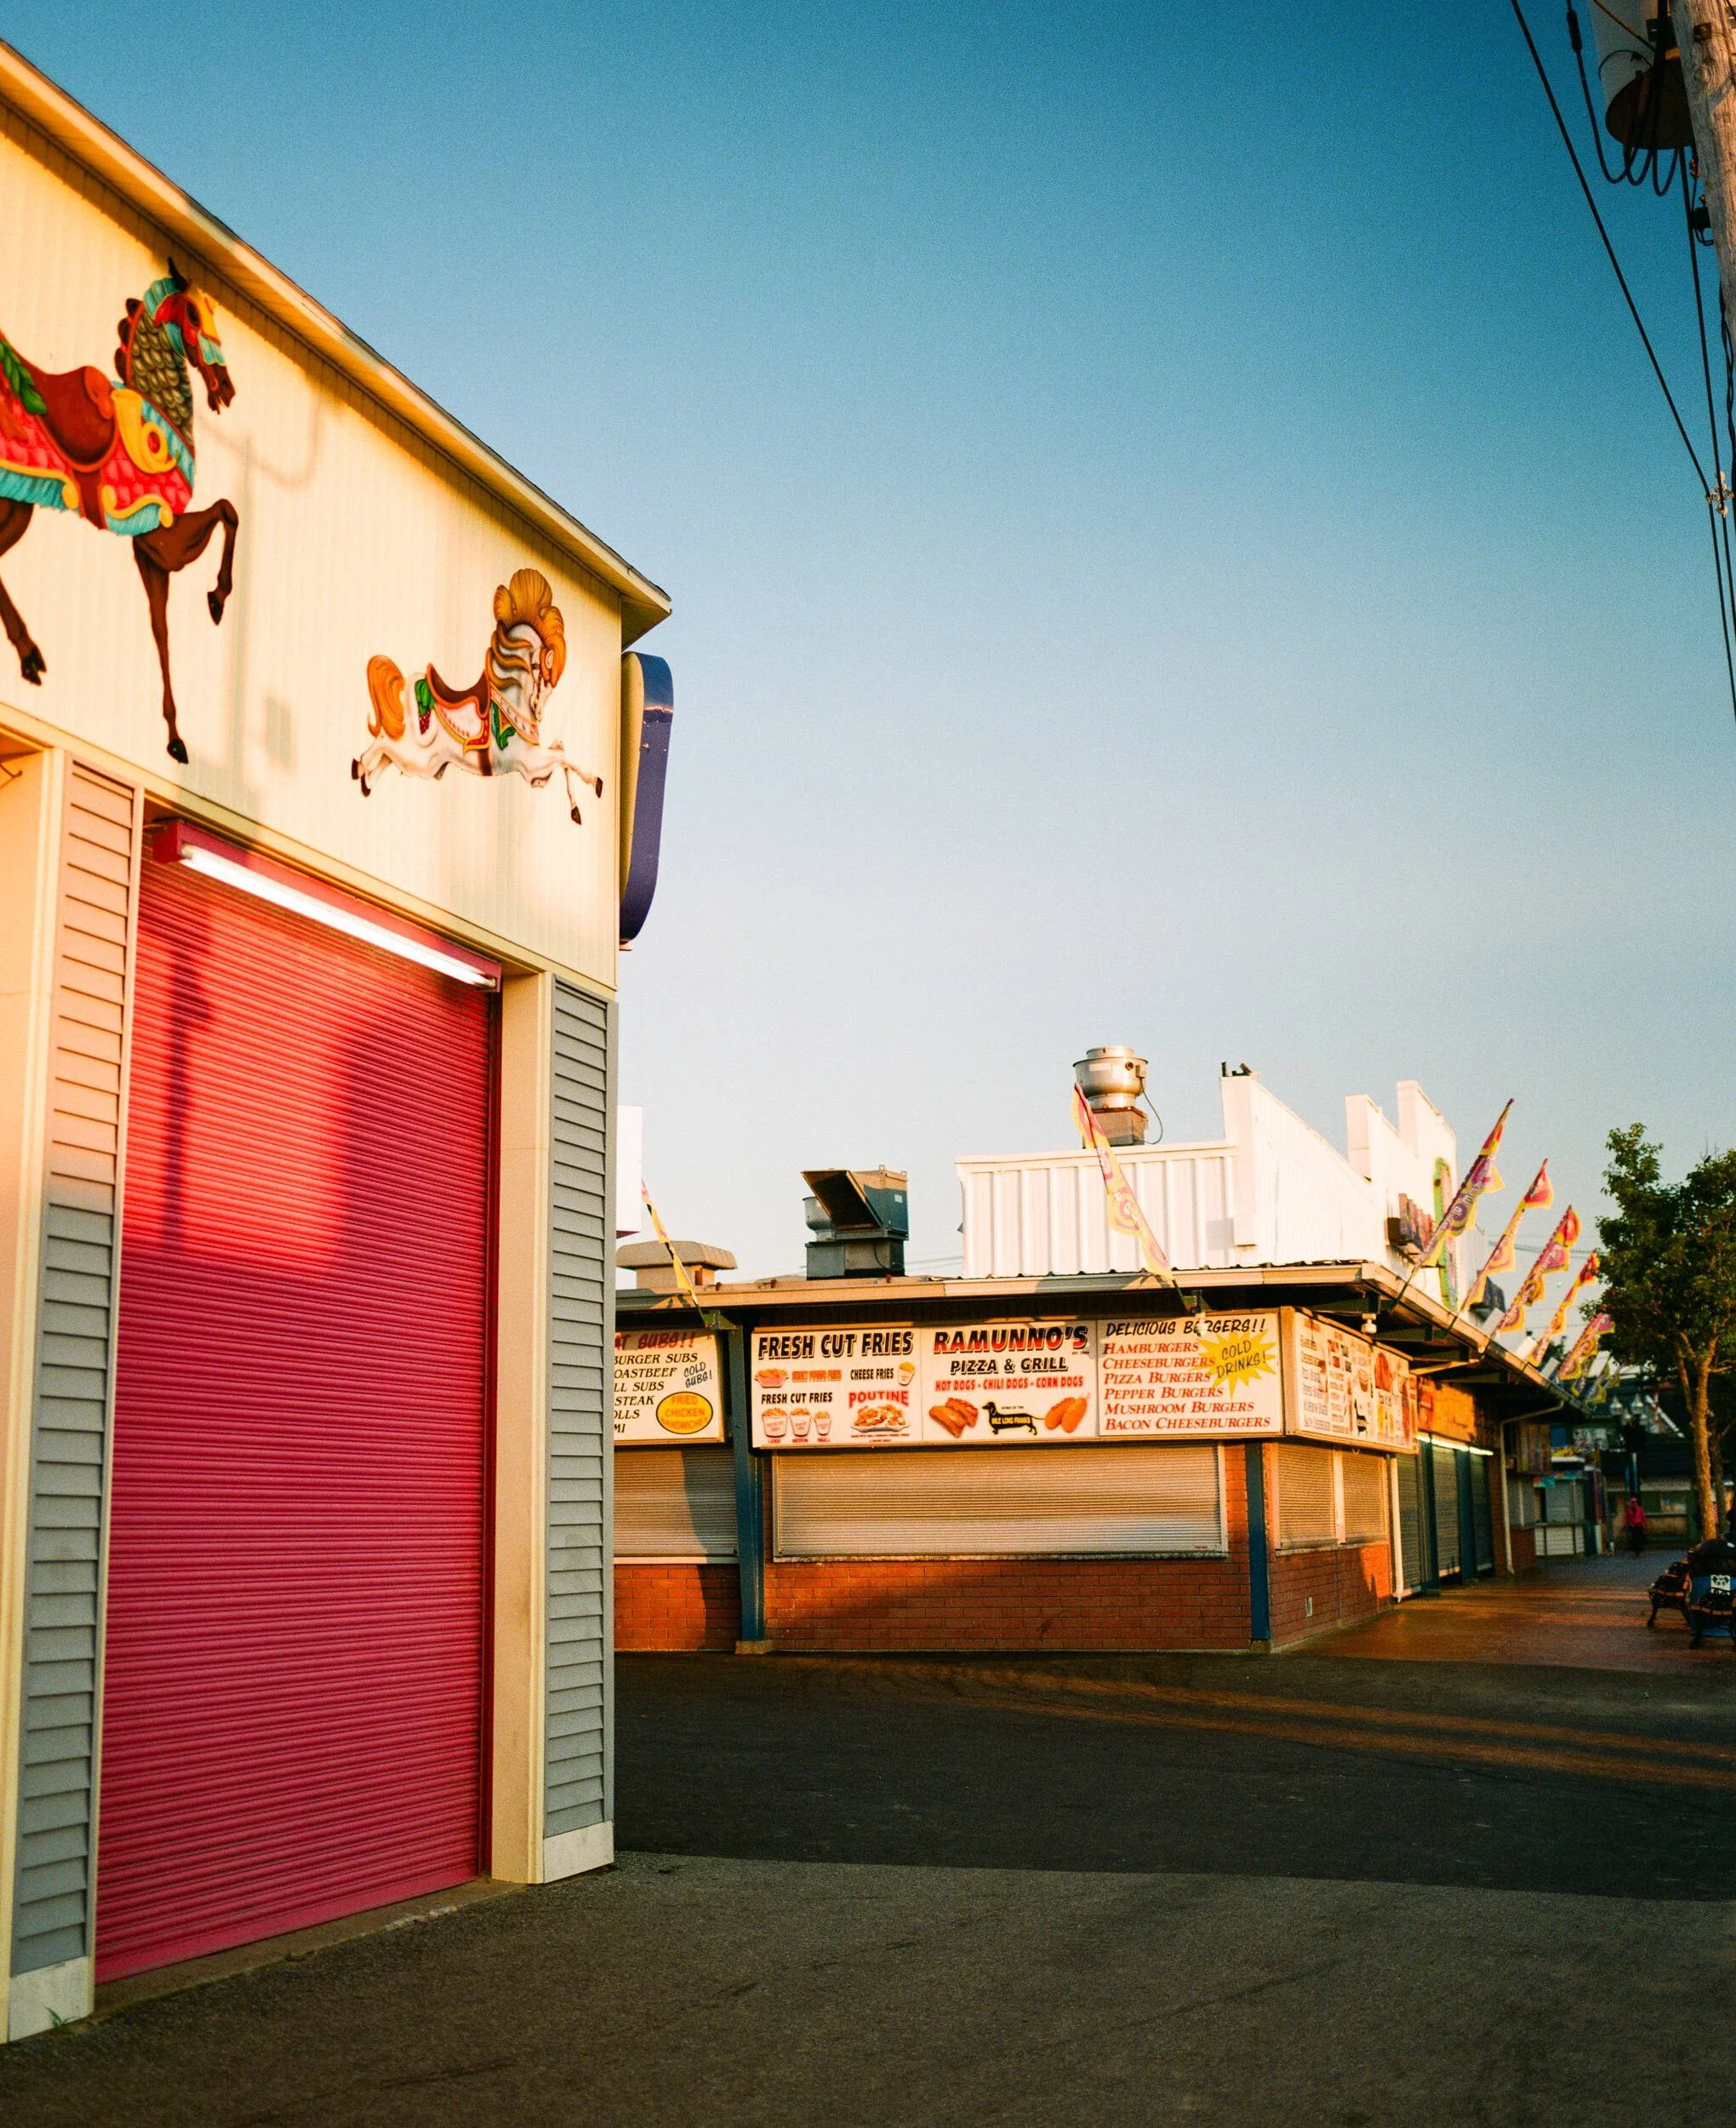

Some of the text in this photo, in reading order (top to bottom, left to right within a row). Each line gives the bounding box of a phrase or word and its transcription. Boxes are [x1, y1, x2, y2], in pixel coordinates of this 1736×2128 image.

[1106, 1321, 1176, 1336] DELICIOUS
[637, 1332, 696, 1350] SUBS!!
[758, 1331, 914, 1360] FRESH CUT FRIES
[934, 1325, 1089, 1354] RAMUNNO'S
[1103, 1342, 1199, 1355] HAMBURGERS
[1221, 1340, 1252, 1360] COLD
[665, 1353, 698, 1364] SUBS
[1103, 1357, 1216, 1370] CHEESEBURGERS
[1217, 1350, 1266, 1378] DRINKS!
[614, 1367, 677, 1379] OASTBEEF
[683, 1361, 706, 1378] COLD
[951, 1357, 1068, 1376] PIZZA & GRILL
[686, 1370, 712, 1388] SUBS!
[851, 1368, 874, 1381] CHEESE
[877, 1368, 894, 1380] FRIES
[1104, 1371, 1211, 1385] PIZZA BURGERS
[632, 1381, 665, 1392] SUBS
[935, 1380, 951, 1392] HOT
[954, 1379, 975, 1391] DOGS
[983, 1378, 1004, 1390] CHILI
[1006, 1377, 1028, 1389] DOGS
[1036, 1376, 1058, 1388] CORN
[1060, 1376, 1083, 1387] DOGS
[614, 1395, 655, 1406] STEAK
[671, 1395, 698, 1405] FRIED
[762, 1392, 832, 1404] FRESH CUT FRIES
[848, 1390, 909, 1409] POUTINE
[1104, 1387, 1224, 1400] PEPPER BURGERS
[665, 1408, 705, 1417] CHICKEN
[1105, 1401, 1254, 1416] MUSHROOM BURGERS
[1105, 1416, 1271, 1431] BACON CHEESEBURGERS
